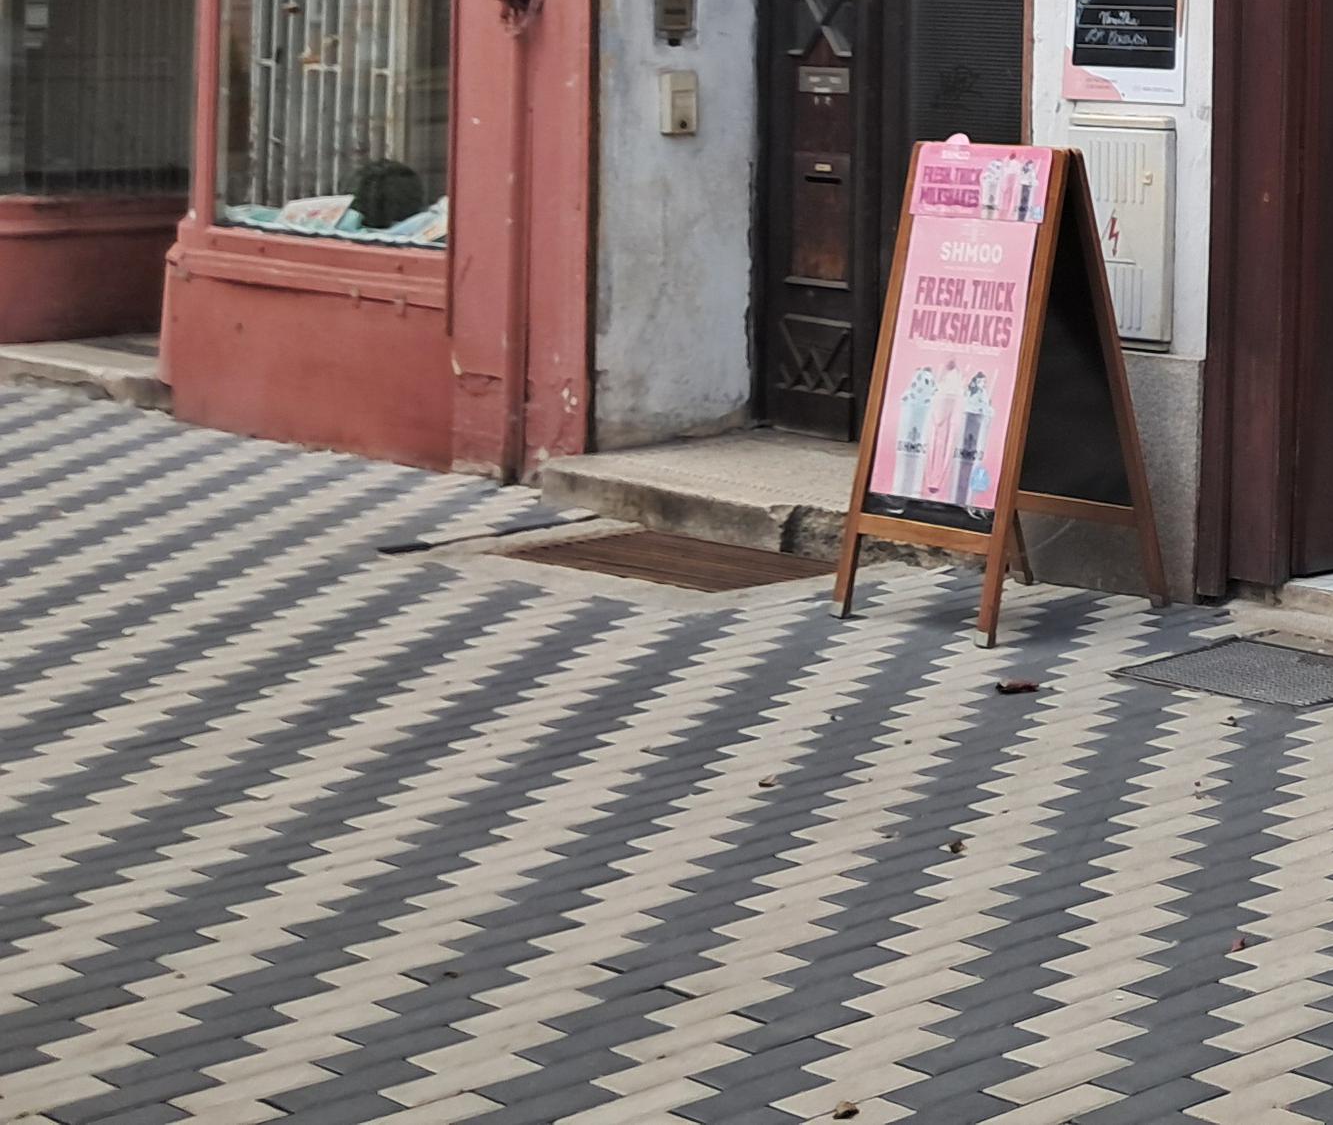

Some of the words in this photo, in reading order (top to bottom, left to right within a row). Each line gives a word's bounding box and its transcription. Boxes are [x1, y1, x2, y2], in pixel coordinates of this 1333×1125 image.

[939, 241, 1003, 264] SHMOO
[971, 279, 1017, 313] THICK
[908, 309, 1014, 349] MILKSHAKES
